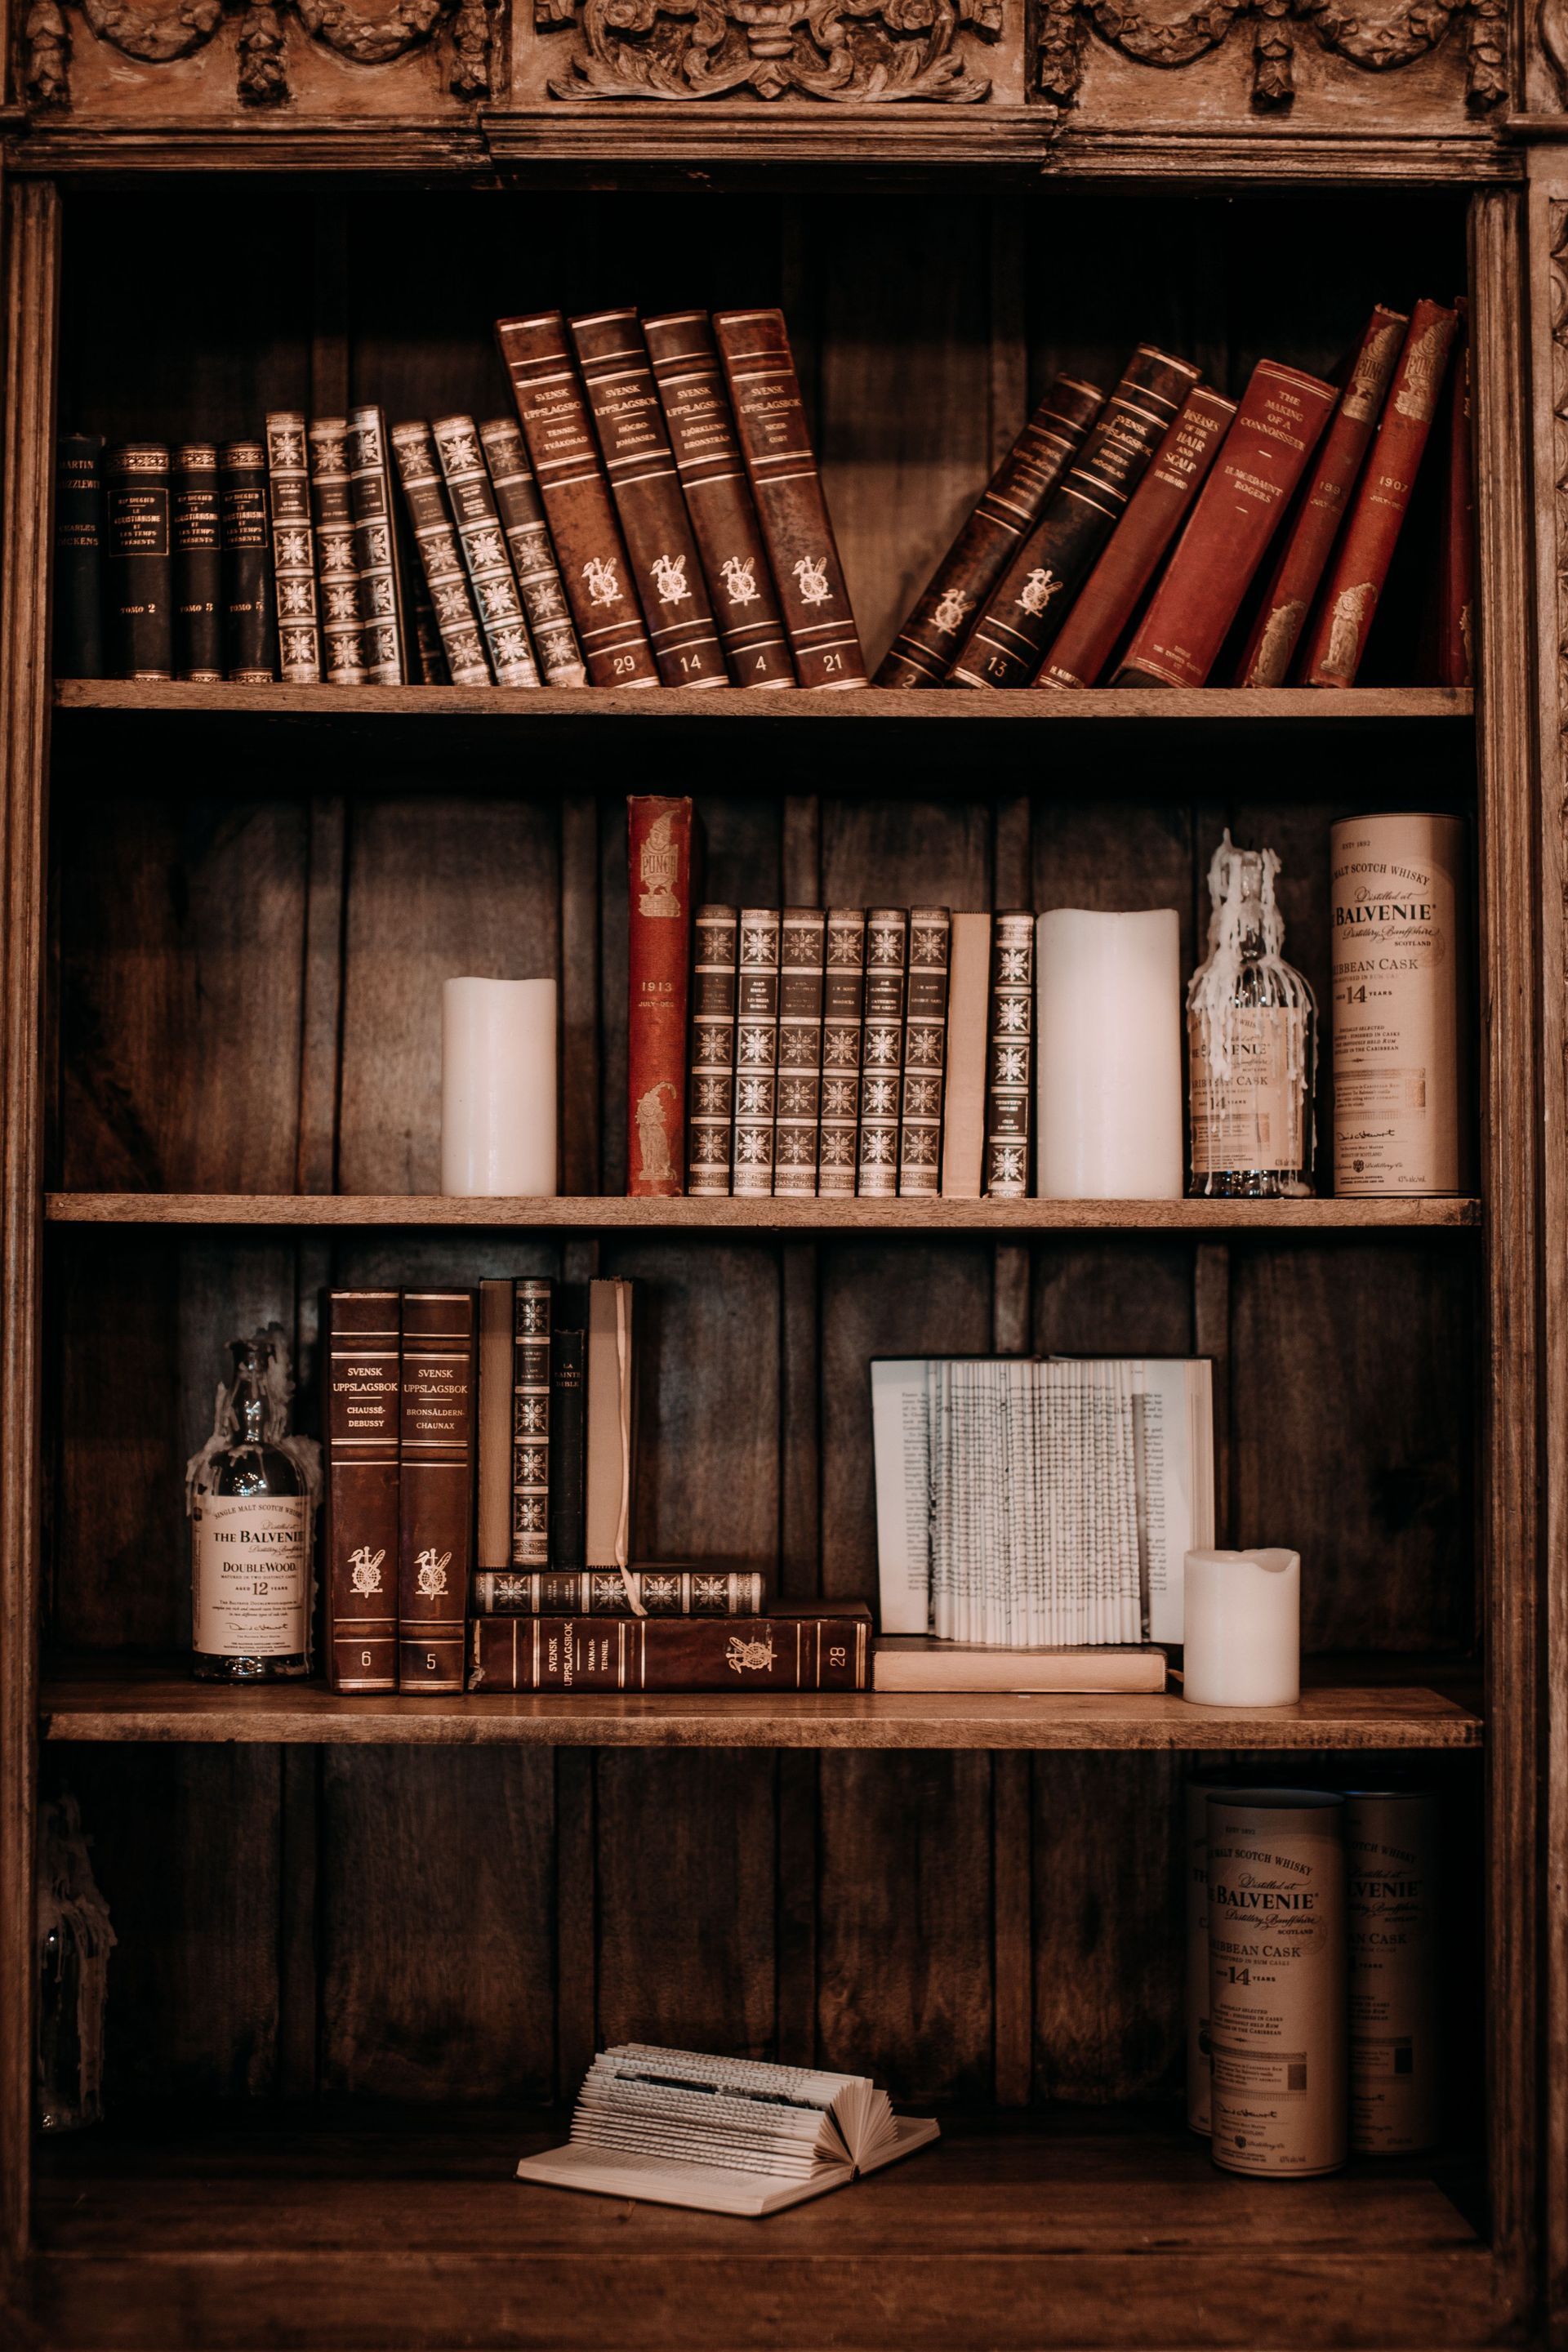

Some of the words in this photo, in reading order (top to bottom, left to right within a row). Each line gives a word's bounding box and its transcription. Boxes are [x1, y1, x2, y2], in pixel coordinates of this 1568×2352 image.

[535, 388, 570, 402] SVENSK
[605, 384, 641, 398] SVENSK
[677, 386, 711, 399] SVENSK
[751, 385, 785, 396] SVENSK
[1279, 390, 1301, 407] THE
[523, 401, 581, 419] UPPSLAGSBO
[595, 397, 660, 416] UPPSLAGSBOK
[740, 399, 802, 413] UPPSLAGSBOK
[1264, 399, 1304, 423] MAKING
[1116, 415, 1148, 437] SVENSK
[1183, 408, 1221, 432] DISEASES
[1267, 413, 1284, 425] OF
[1282, 421, 1291, 430] A
[1176, 431, 1205, 452] HAIR
[1176, 446, 1194, 458] AND
[1163, 452, 1197, 474] SCALP
[1234, 480, 1272, 504] ROGERS
[1379, 474, 1409, 493] 1907
[148, 604, 156, 612] 2
[206, 603, 213, 612] 3
[256, 602, 263, 610] 5
[613, 655, 636, 675] 29
[679, 654, 702, 672] 14
[755, 655, 767, 670] 4
[822, 653, 844, 672] 21
[987, 656, 1007, 677] 13
[902, 674, 916, 689] 2
[643, 855, 676, 876] PUNCH
[1350, 862, 1388, 874] SCOTCH
[1391, 865, 1430, 886] WHISKY
[1353, 885, 1402, 902] Distilled
[1336, 903, 1432, 927] BALVENIE
[1379, 958, 1419, 970] CASK
[642, 981, 672, 992] 1913
[1346, 984, 1368, 1004] 14
[347, 1367, 384, 1377] SVENSK
[417, 1369, 454, 1379] SVENSK
[332, 1383, 399, 1392] UPPSLAGSBOK
[403, 1384, 469, 1394] UPPSLAGSBOK
[346, 1405, 386, 1414] CHAUSSÉ-
[406, 1408, 466, 1417] BRONSÅLDERN-
[348, 1419, 385, 1428] DEBUSSY
[416, 1422, 455, 1430] CHAUNAX
[215, 1507, 237, 1520] SINGLE
[213, 1532, 237, 1543] THE
[252, 1582, 269, 1596] 12
[361, 1650, 372, 1667] 6
[425, 1653, 436, 1670] 5
[549, 1637, 558, 1673] SVENSK
[564, 1622, 573, 1687] UPPSLAGSBOK
[601, 1638, 609, 1672] TENNIEL
[830, 1646, 846, 1667] 28
[1234, 1849, 1272, 1864] SCOTCH
[1274, 1855, 1313, 1877] WHISKY
[1238, 1872, 1285, 1890] Distilled
[1217, 1884, 1315, 1910] BALVENIE
[1370, 1932, 1406, 1944] CASK
[1262, 1944, 1302, 1958] CASK
[1227, 1966, 1251, 1986] 14
